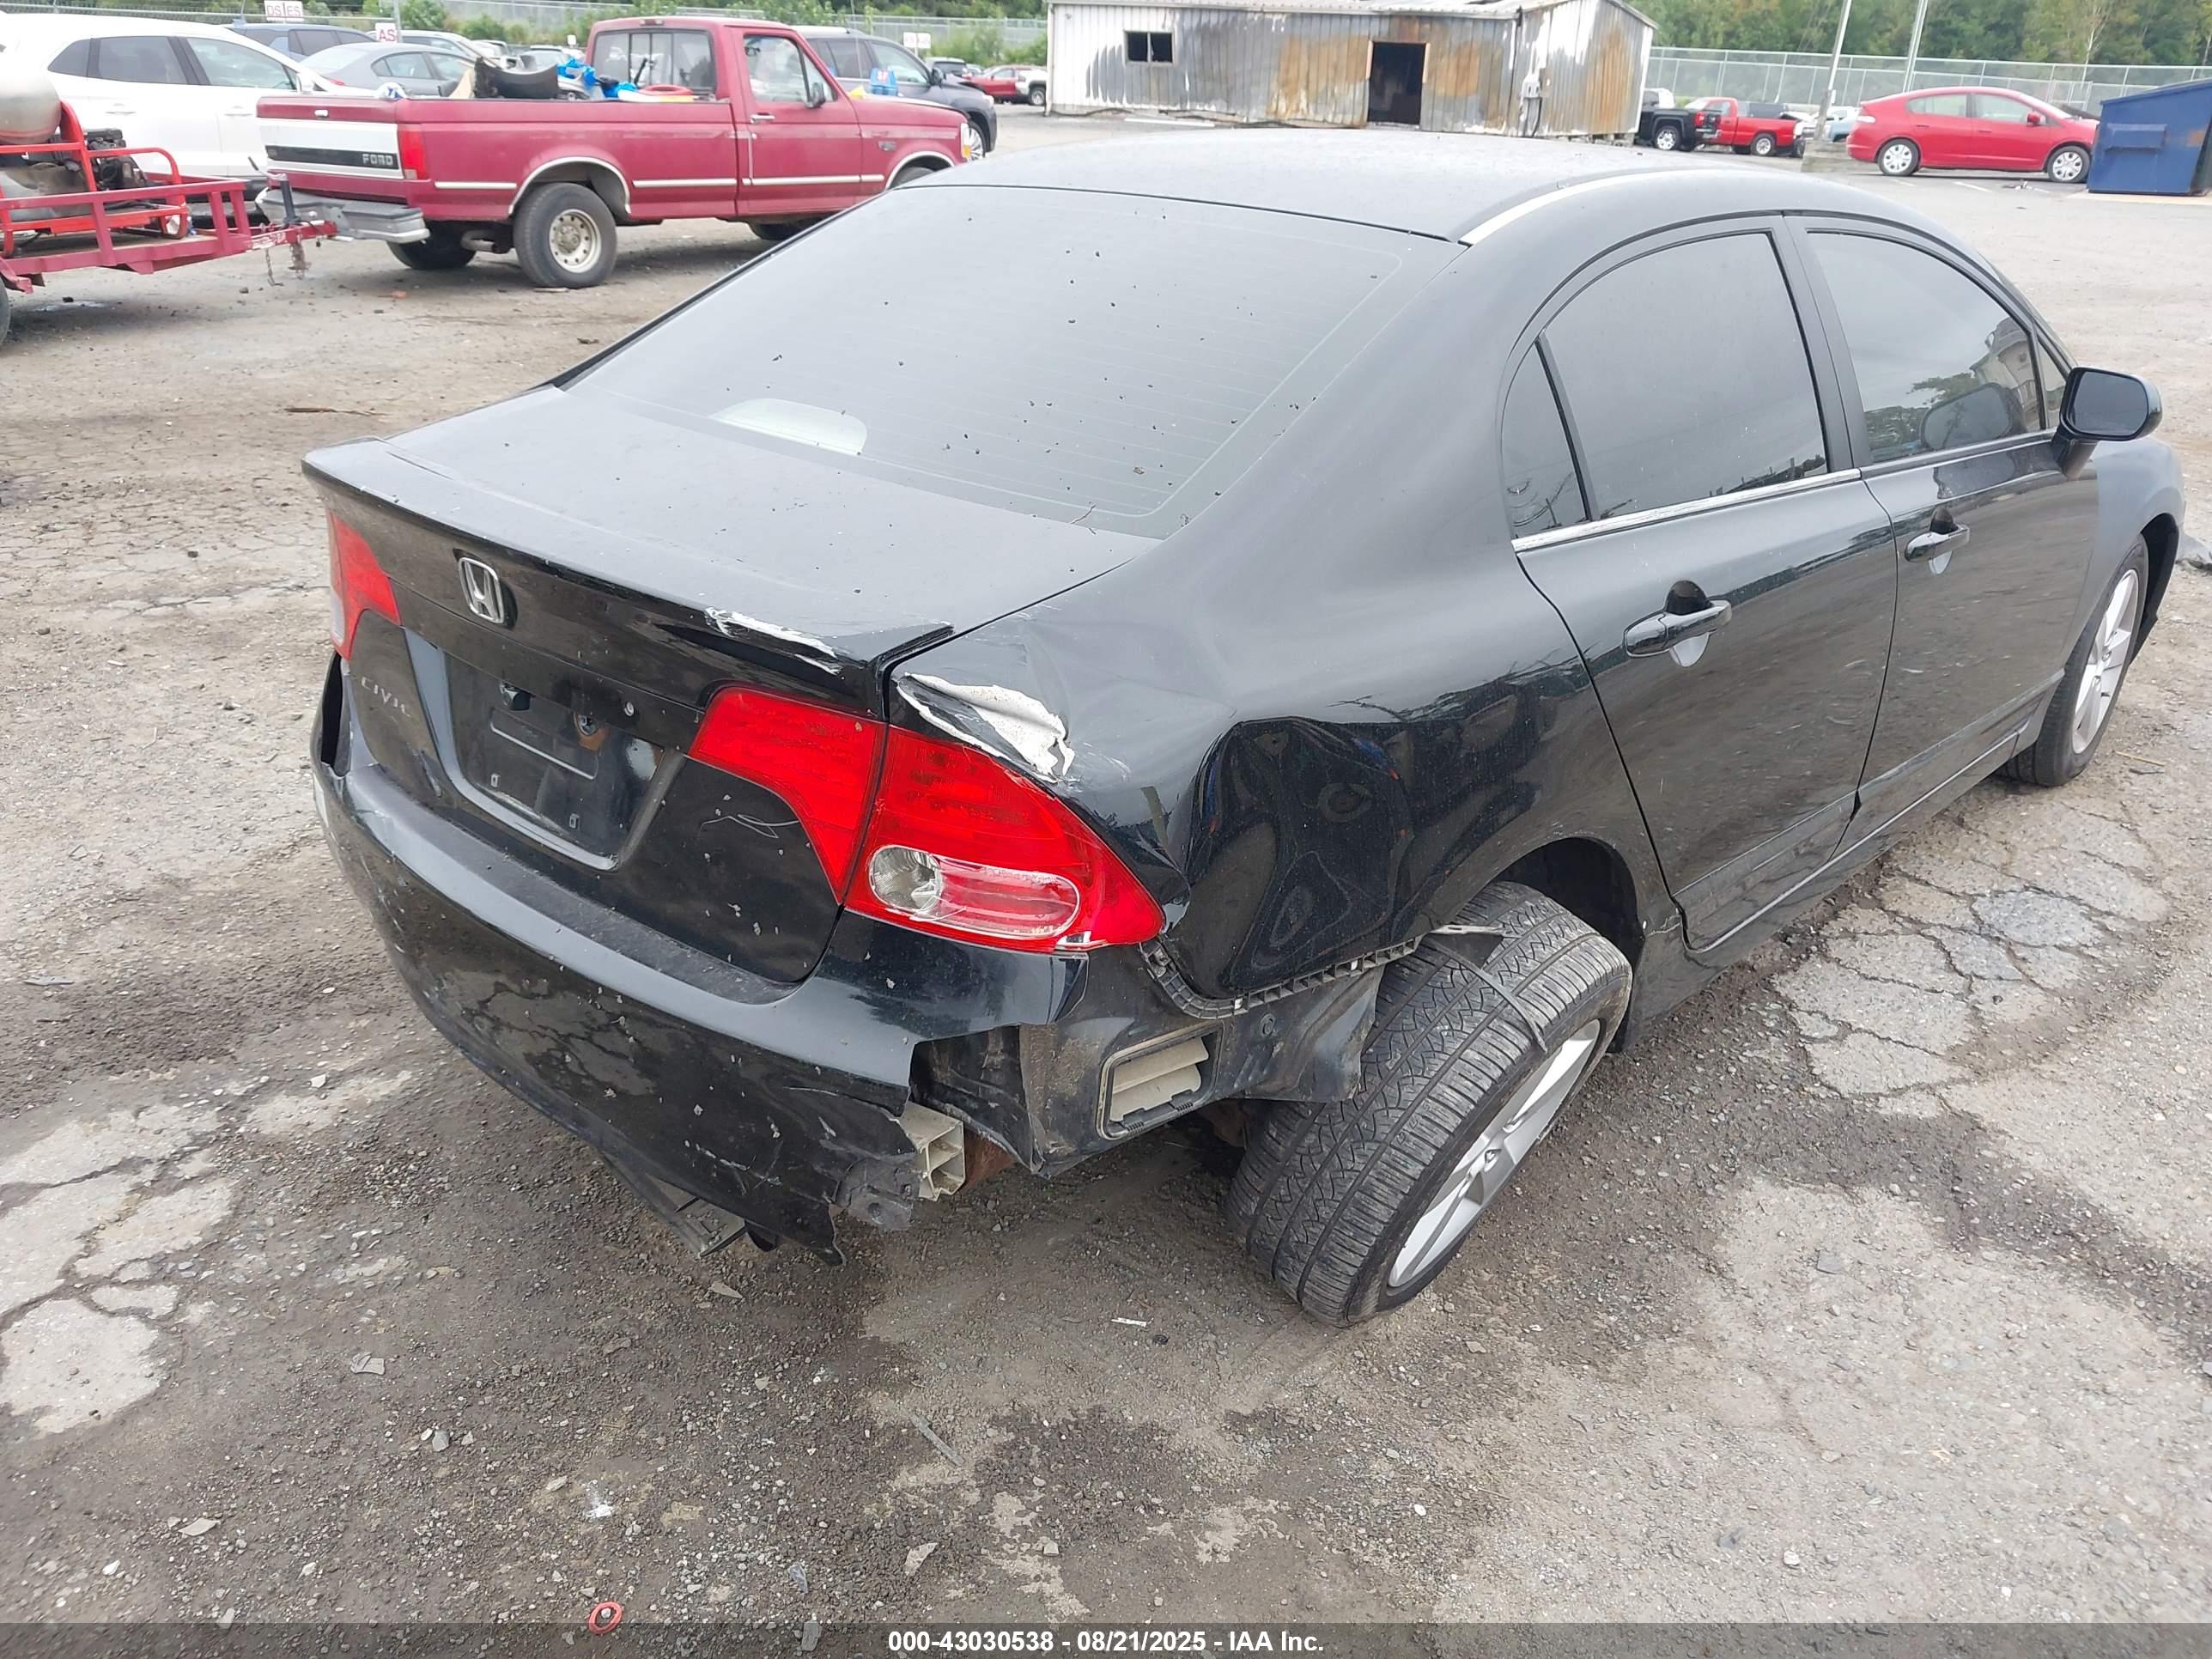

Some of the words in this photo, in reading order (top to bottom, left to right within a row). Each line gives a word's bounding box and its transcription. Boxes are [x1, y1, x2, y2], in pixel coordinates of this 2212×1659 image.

[379, 29, 397, 42] AS
[362, 153, 393, 166] FORD
[361, 676, 411, 718] CIVIC
